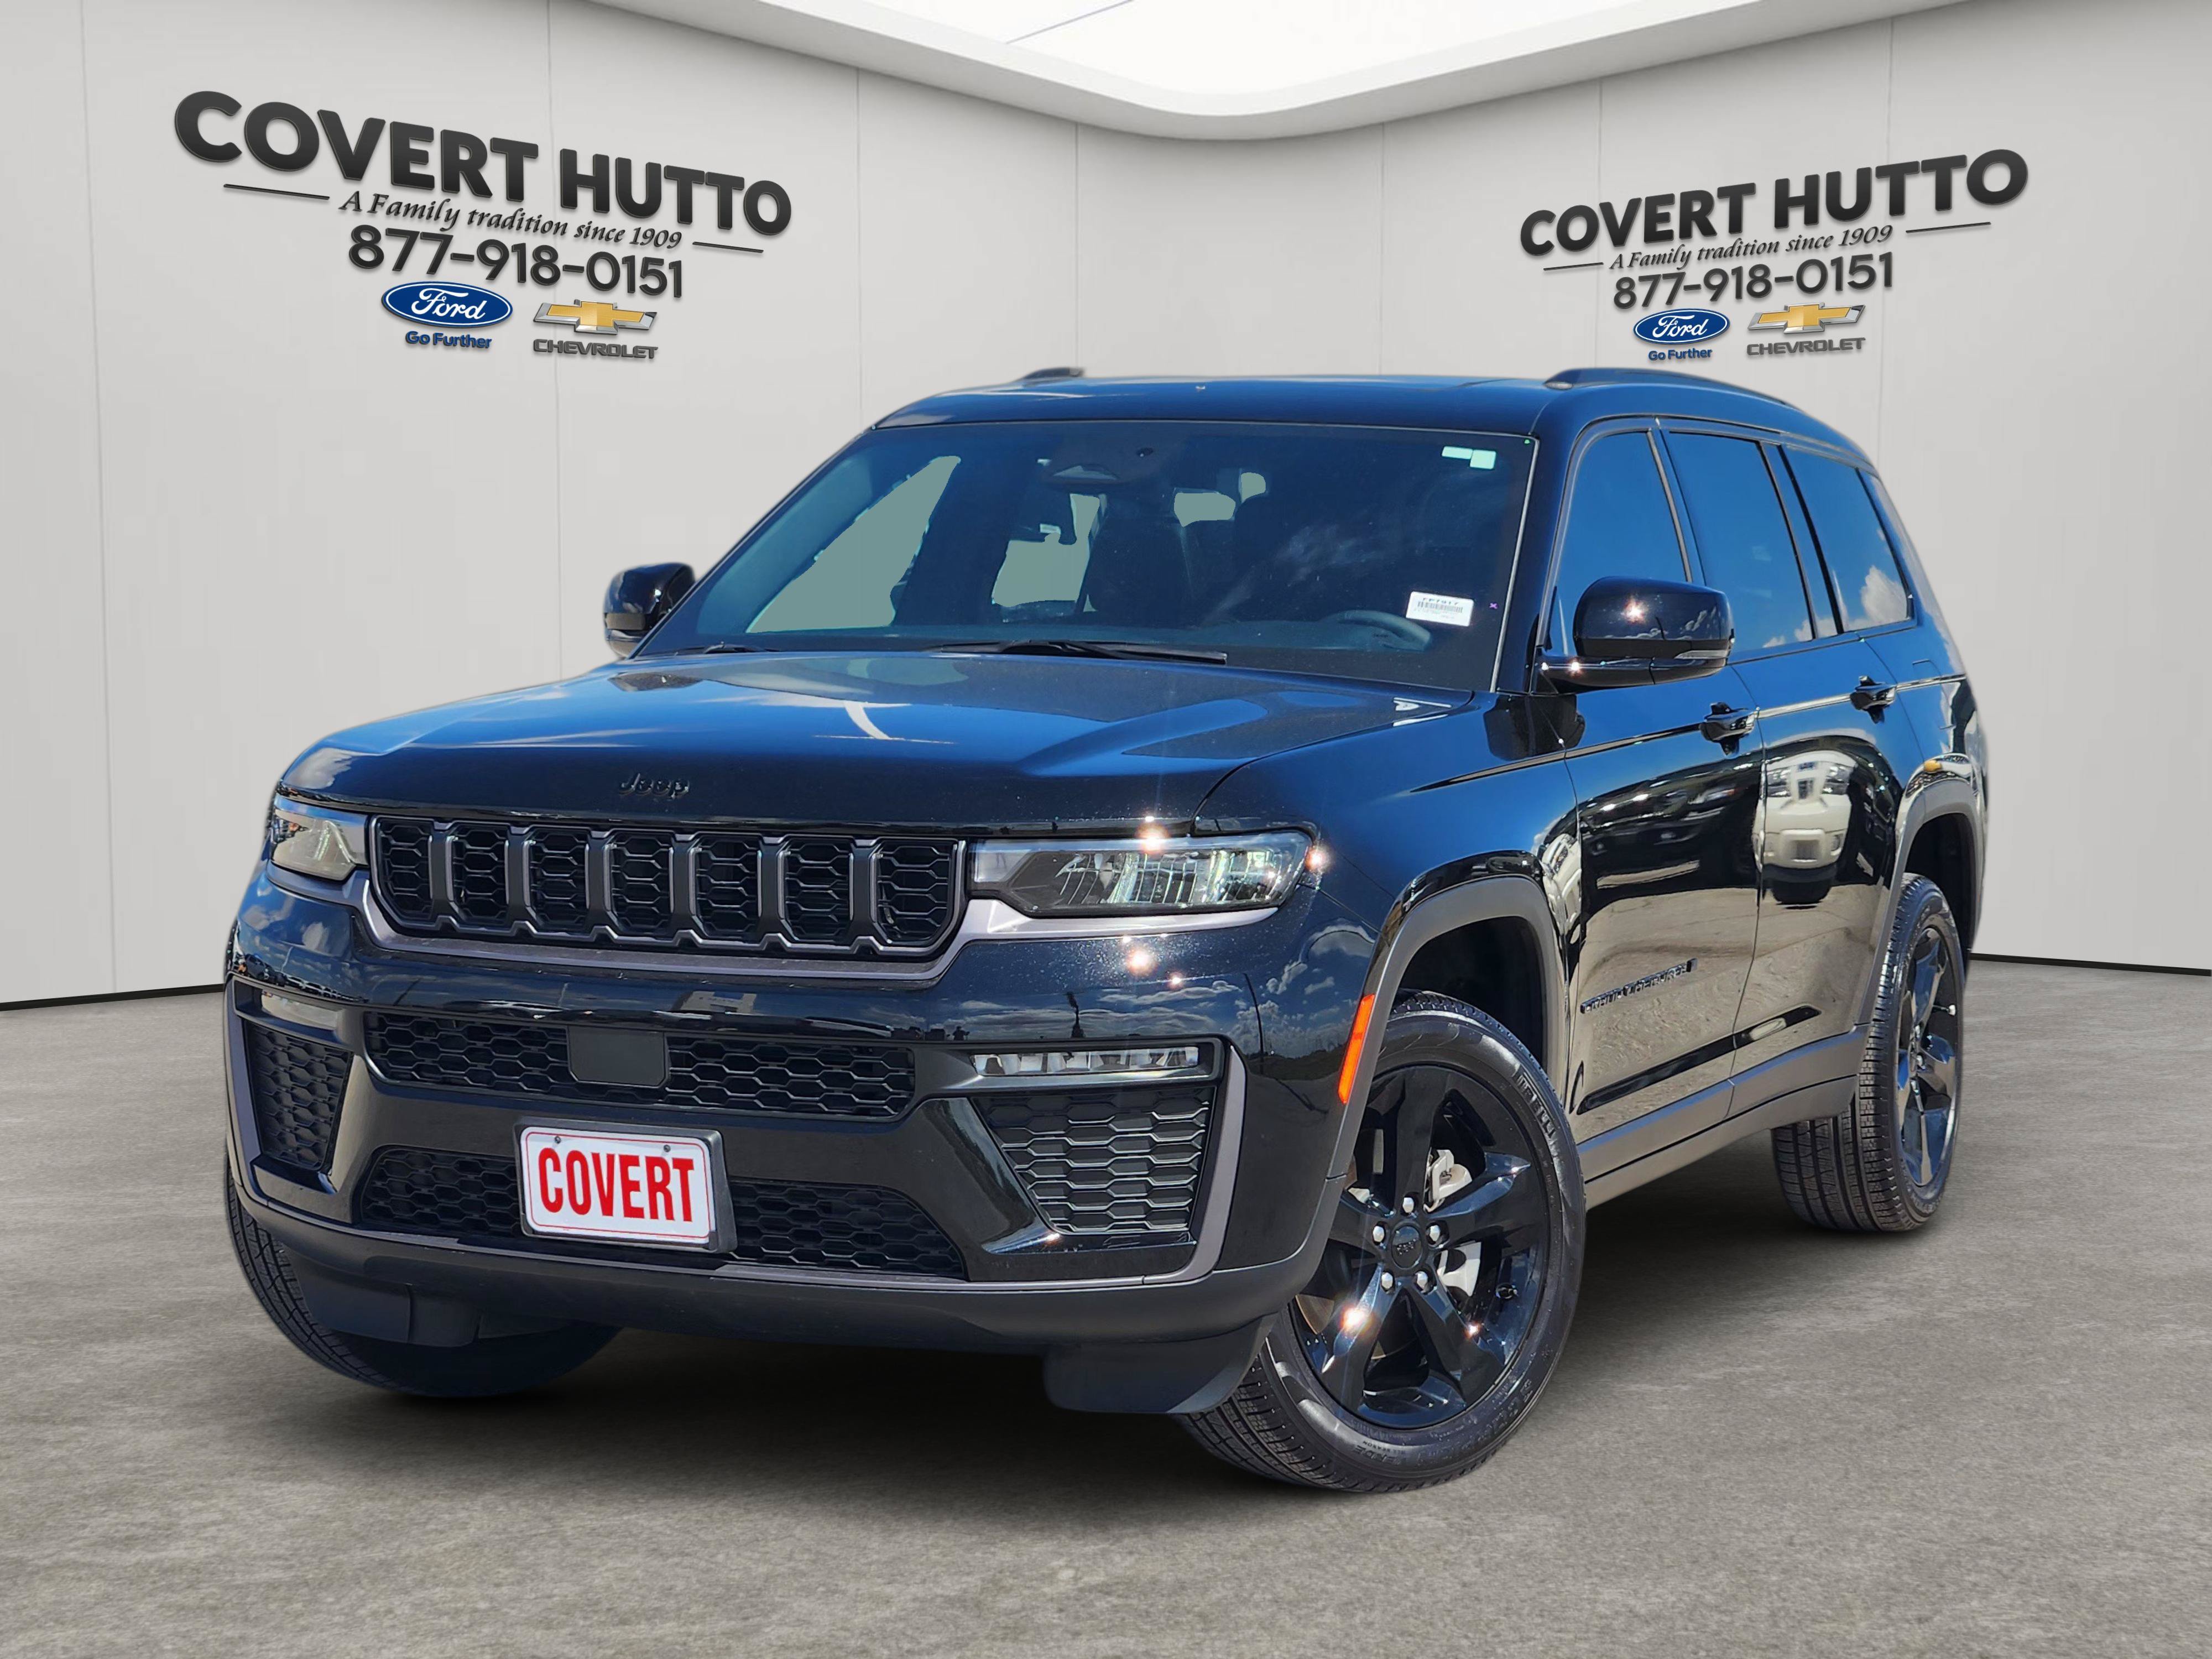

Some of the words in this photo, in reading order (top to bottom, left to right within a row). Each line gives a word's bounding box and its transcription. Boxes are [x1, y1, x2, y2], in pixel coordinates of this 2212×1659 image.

[174, 91, 539, 203] COVERT
[560, 148, 791, 236] HUTTO
[338, 191, 362, 212] A
[367, 193, 461, 232] Family
[467, 208, 568, 236] tradition
[573, 221, 625, 243] since
[629, 227, 682, 249] 1909
[1520, 182, 1756, 257] COVERT
[1774, 149, 2028, 229] HUTTO
[348, 225, 682, 299] 877-918-0151
[1609, 253, 1624, 270] A
[1627, 244, 1692, 270] Family
[1697, 238, 1780, 261] tradition
[1785, 234, 1834, 252] since
[1838, 225, 1893, 247] 1909
[1614, 252, 1892, 310] 877-918-0151
[411, 288, 487, 320] Ford
[405, 331, 431, 345] Go
[432, 332, 492, 348] Further
[1652, 315, 1708, 338] Ford
[533, 339, 659, 359] CHEVROLET
[1648, 350, 1666, 361] Go
[1667, 348, 1713, 360] Further
[1746, 337, 1866, 356] CHEVROLET
[619, 773, 690, 800] Jeep
[538, 1147, 695, 1223] COVERT
